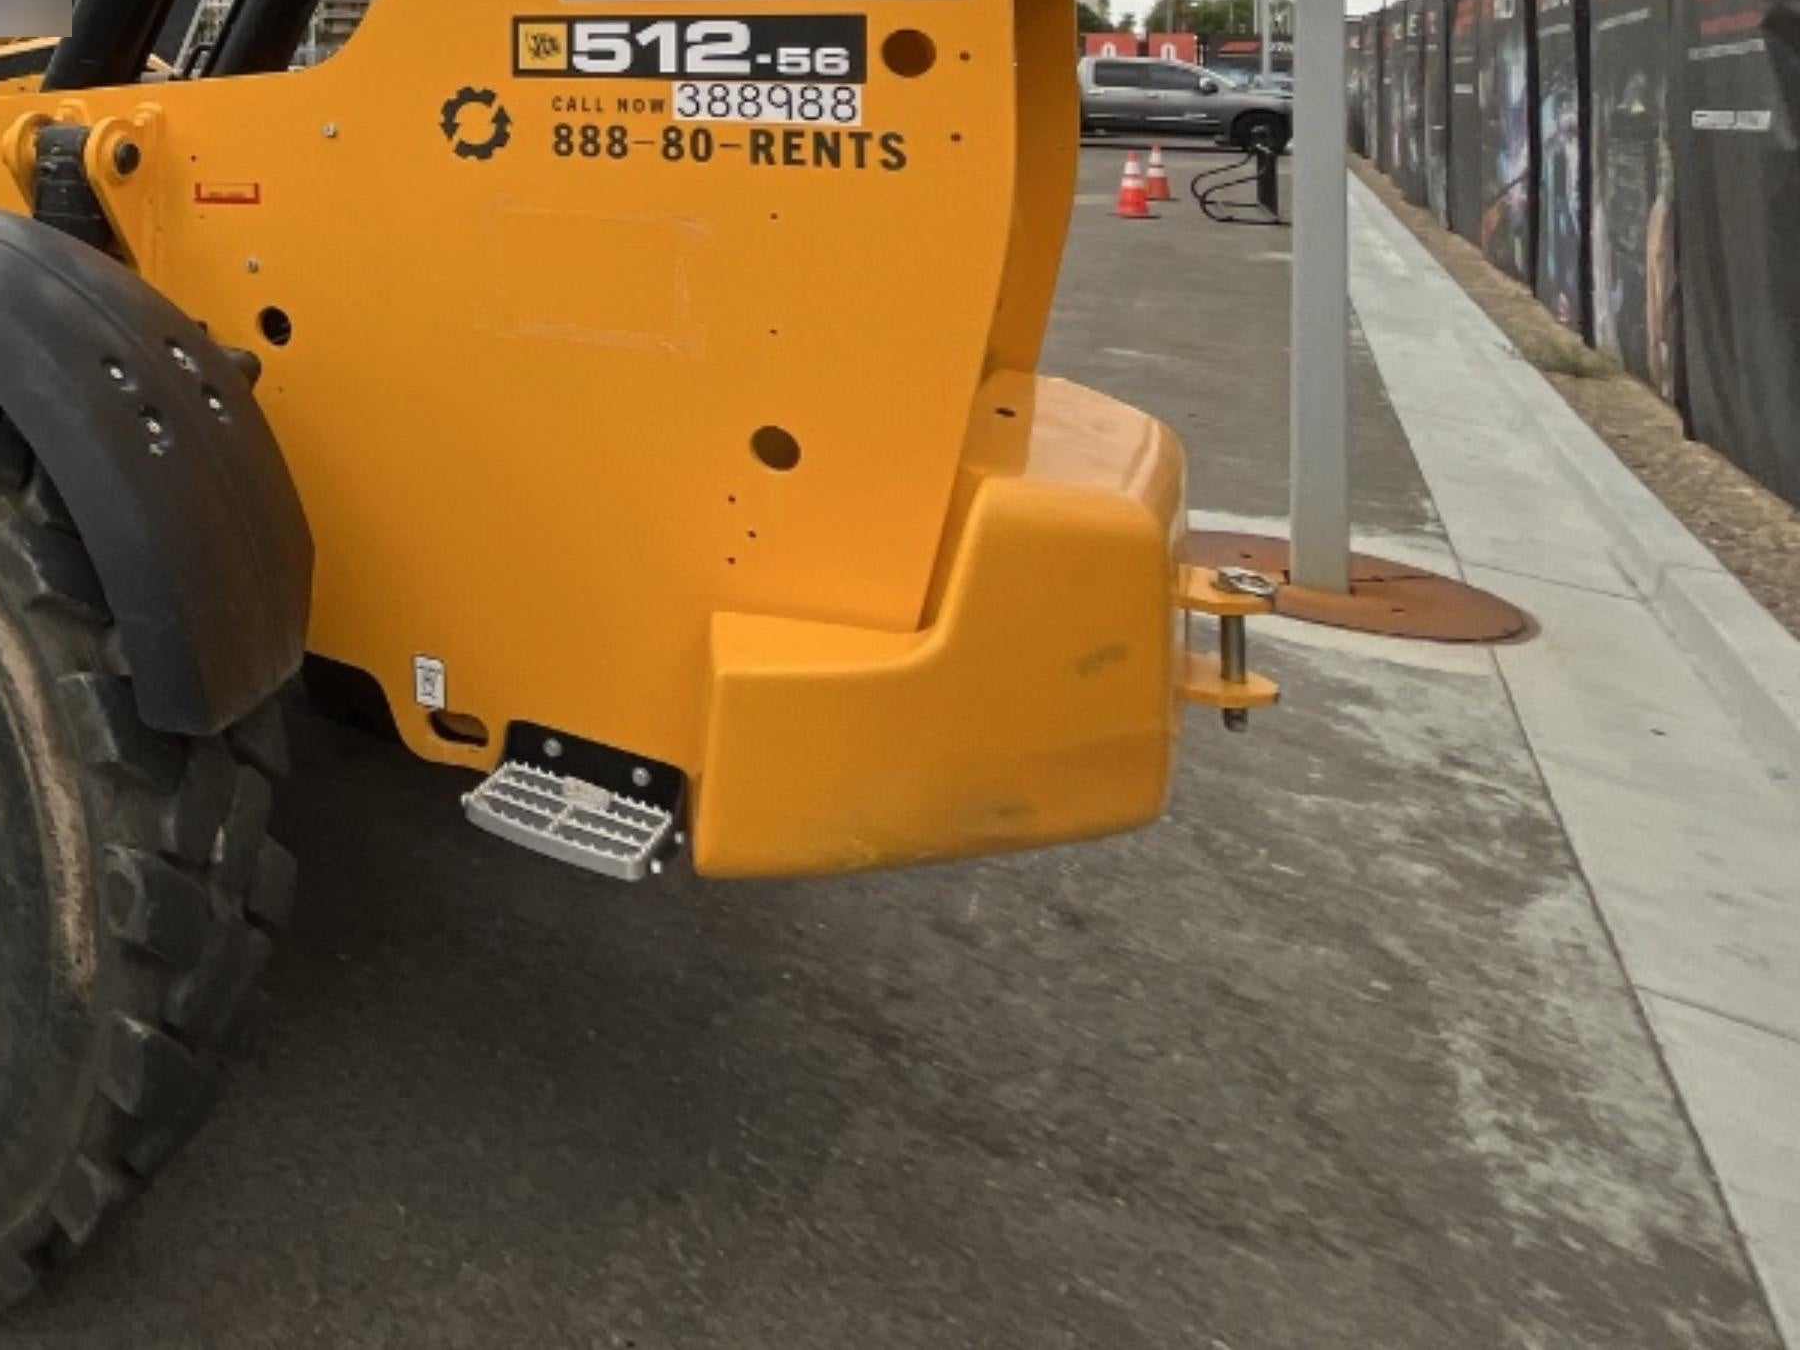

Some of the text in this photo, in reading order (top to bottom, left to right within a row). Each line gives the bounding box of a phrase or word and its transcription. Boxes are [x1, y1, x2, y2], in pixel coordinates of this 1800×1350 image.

[551, 95, 665, 114] CALL NOW
[676, 82, 857, 123] 388988
[552, 123, 908, 171] 888-80-RENTS
